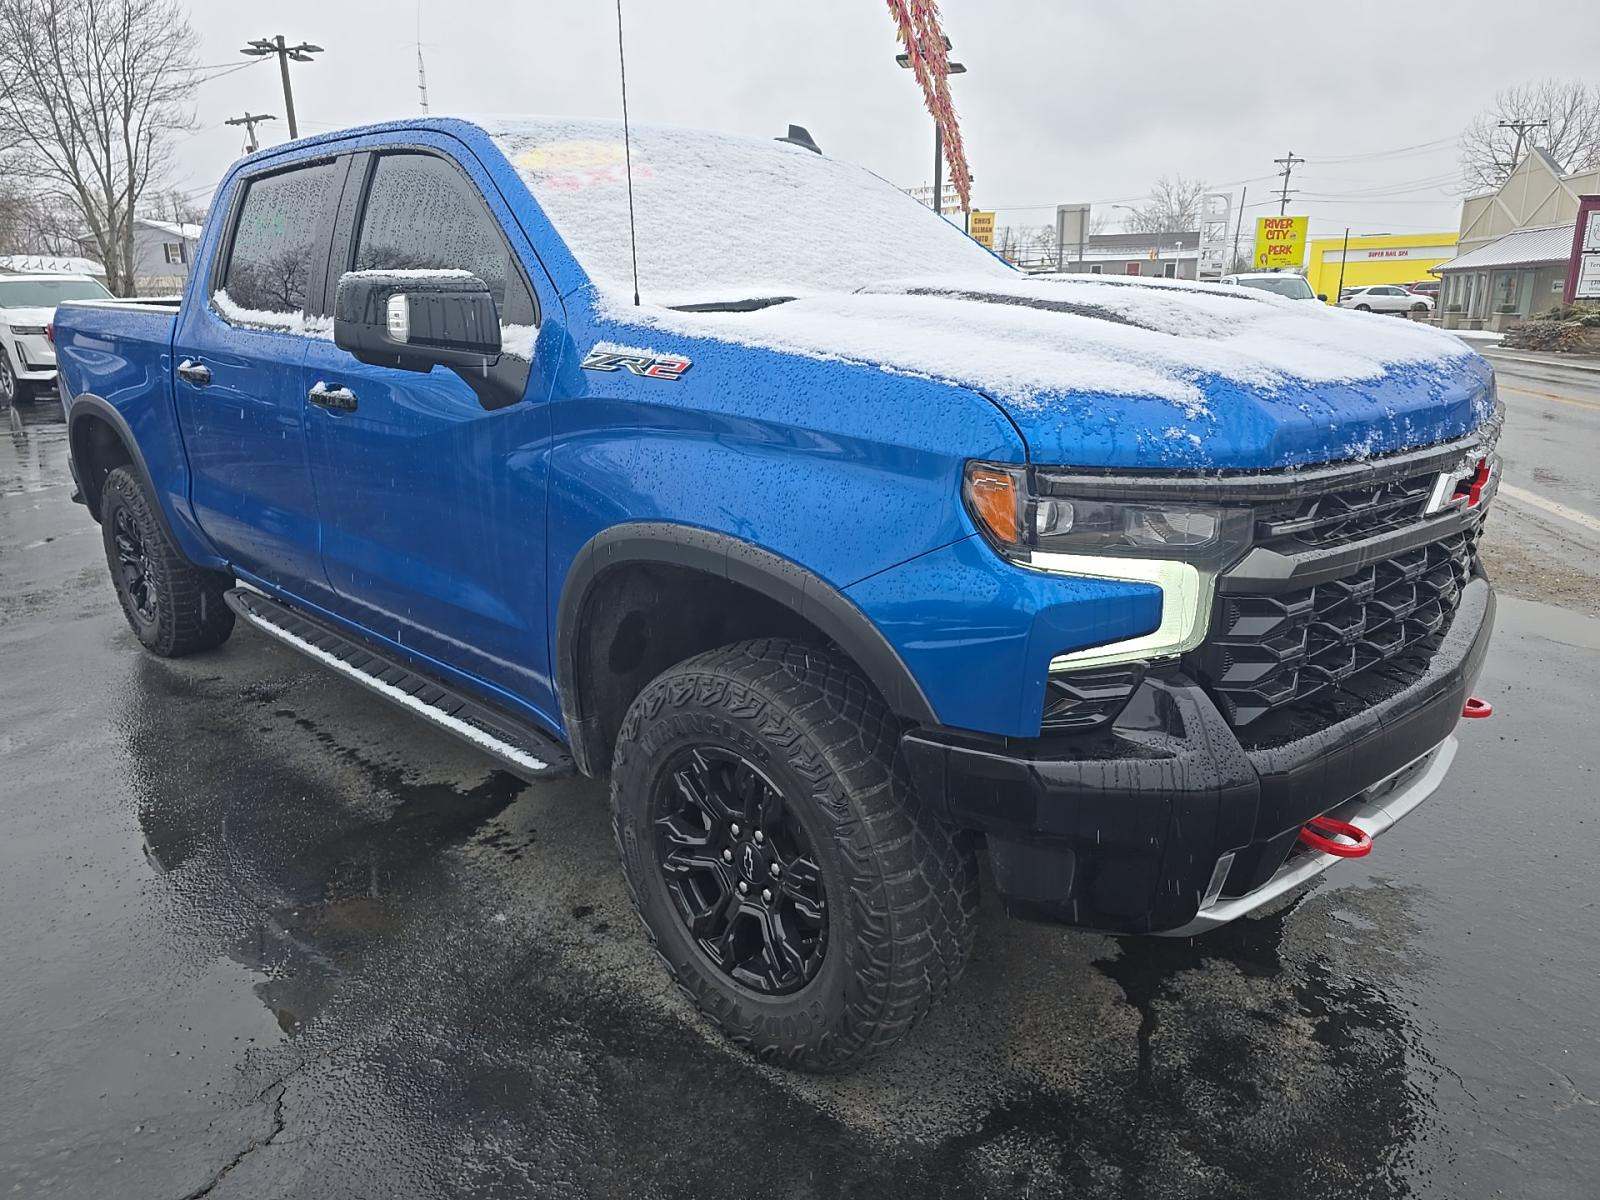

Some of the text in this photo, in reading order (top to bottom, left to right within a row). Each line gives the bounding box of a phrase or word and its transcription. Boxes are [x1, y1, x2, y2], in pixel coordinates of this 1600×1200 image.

[1264, 218, 1294, 229] RIVER
[1266, 229, 1290, 240] CITY
[1268, 244, 1293, 255] PERK
[580, 348, 694, 382] ZR2
